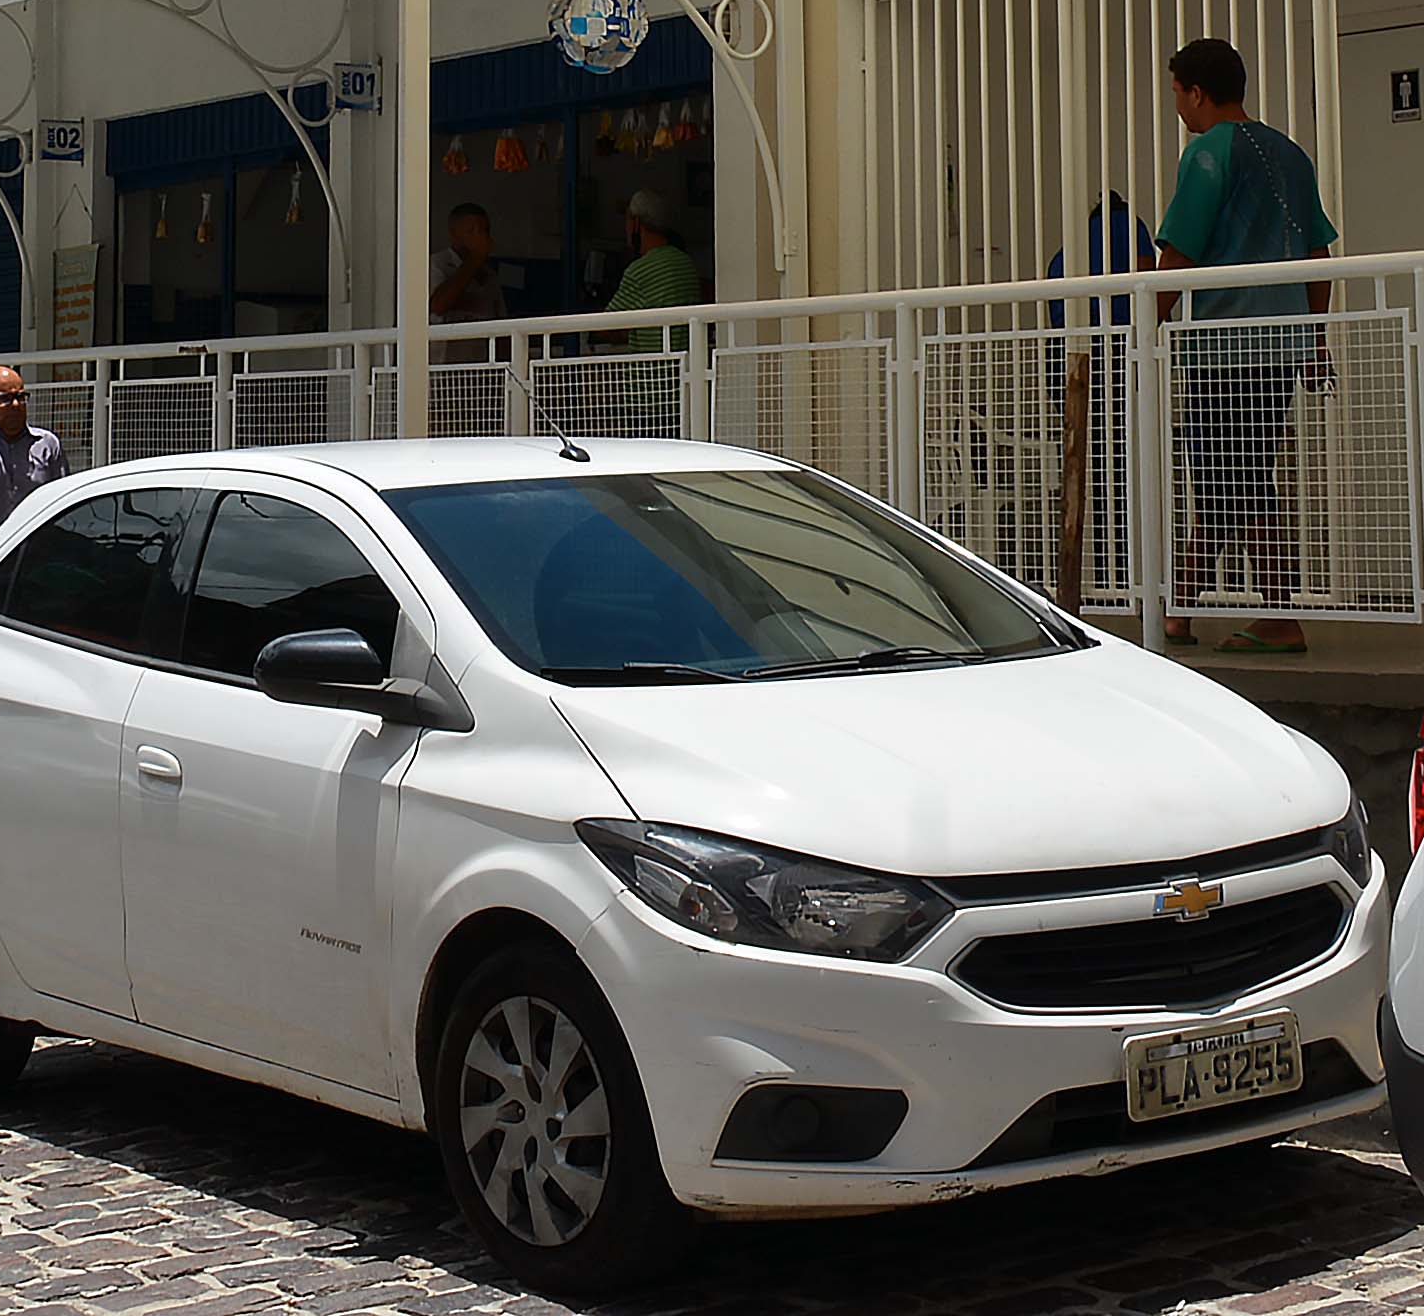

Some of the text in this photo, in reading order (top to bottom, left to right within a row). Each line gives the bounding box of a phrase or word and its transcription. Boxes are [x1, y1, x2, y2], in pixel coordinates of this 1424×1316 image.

[341, 71, 375, 97] BOX 01
[47, 127, 80, 148] BOX 02
